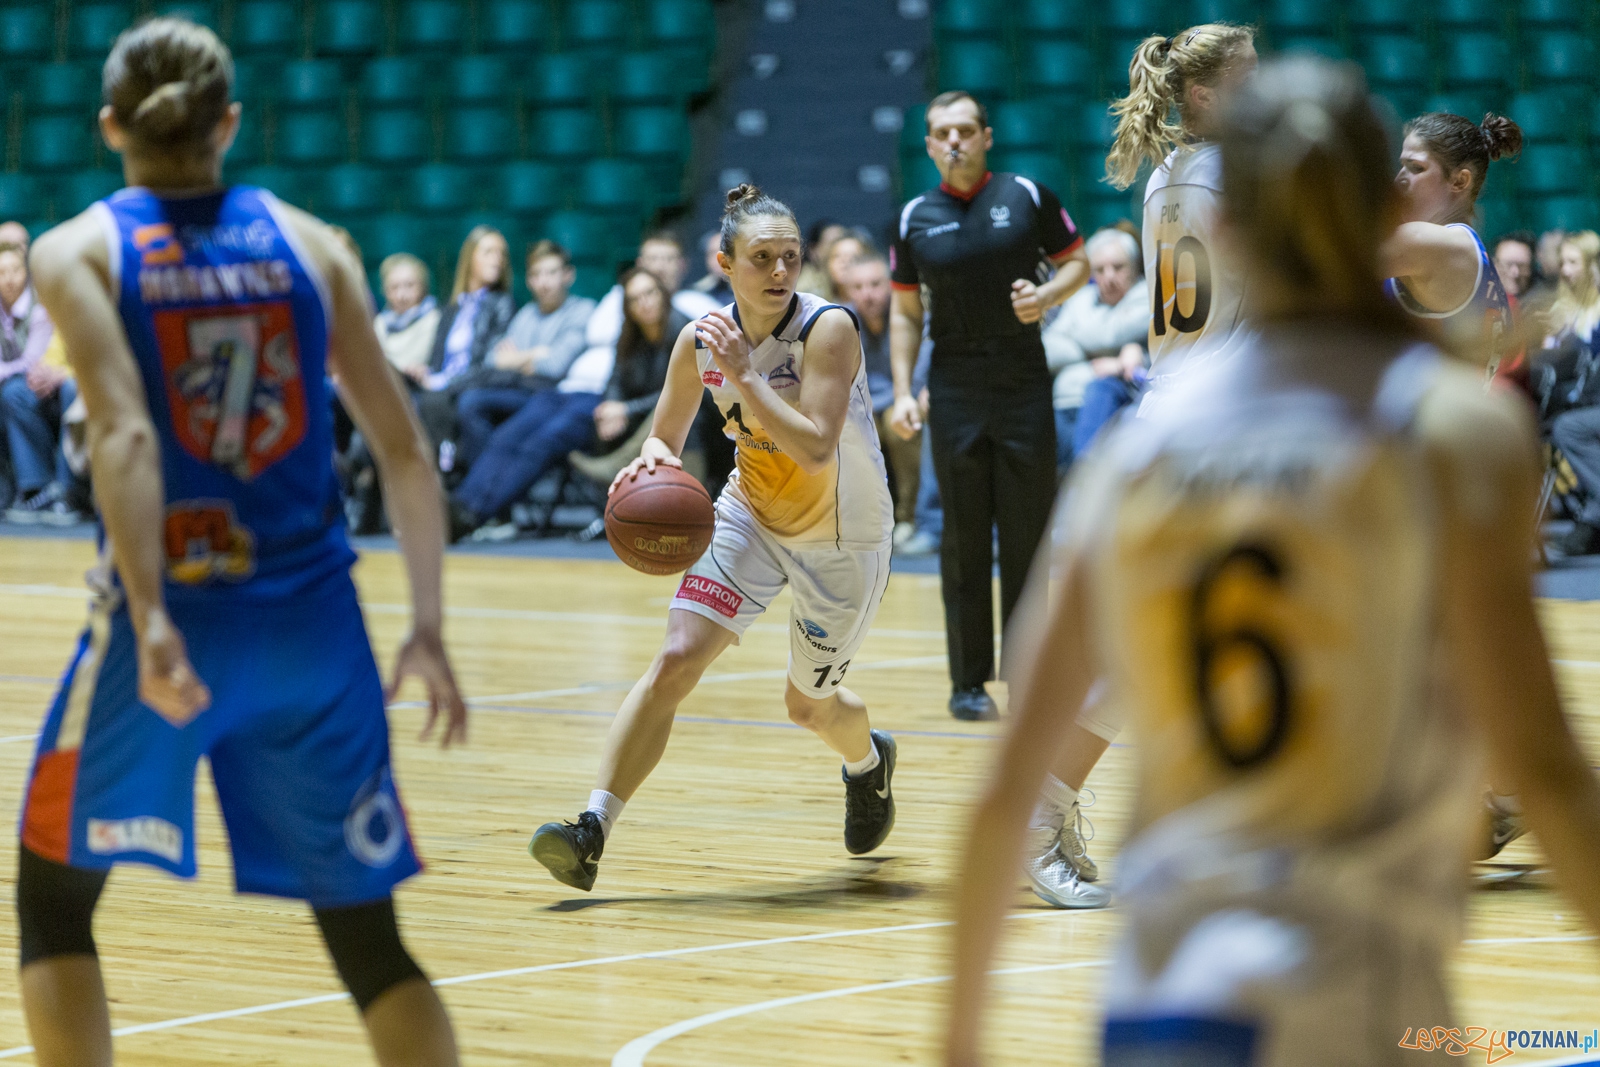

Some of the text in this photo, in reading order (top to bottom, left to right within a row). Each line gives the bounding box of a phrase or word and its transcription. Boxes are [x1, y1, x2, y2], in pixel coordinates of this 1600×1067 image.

[1160, 203, 1180, 224] PUC
[1153, 235, 1212, 337] 10
[187, 314, 259, 464] 7
[684, 577, 739, 609] TAURON
[700, 595, 715, 608] LIGA
[1190, 541, 1292, 773] 6
[813, 659, 851, 689] 13
